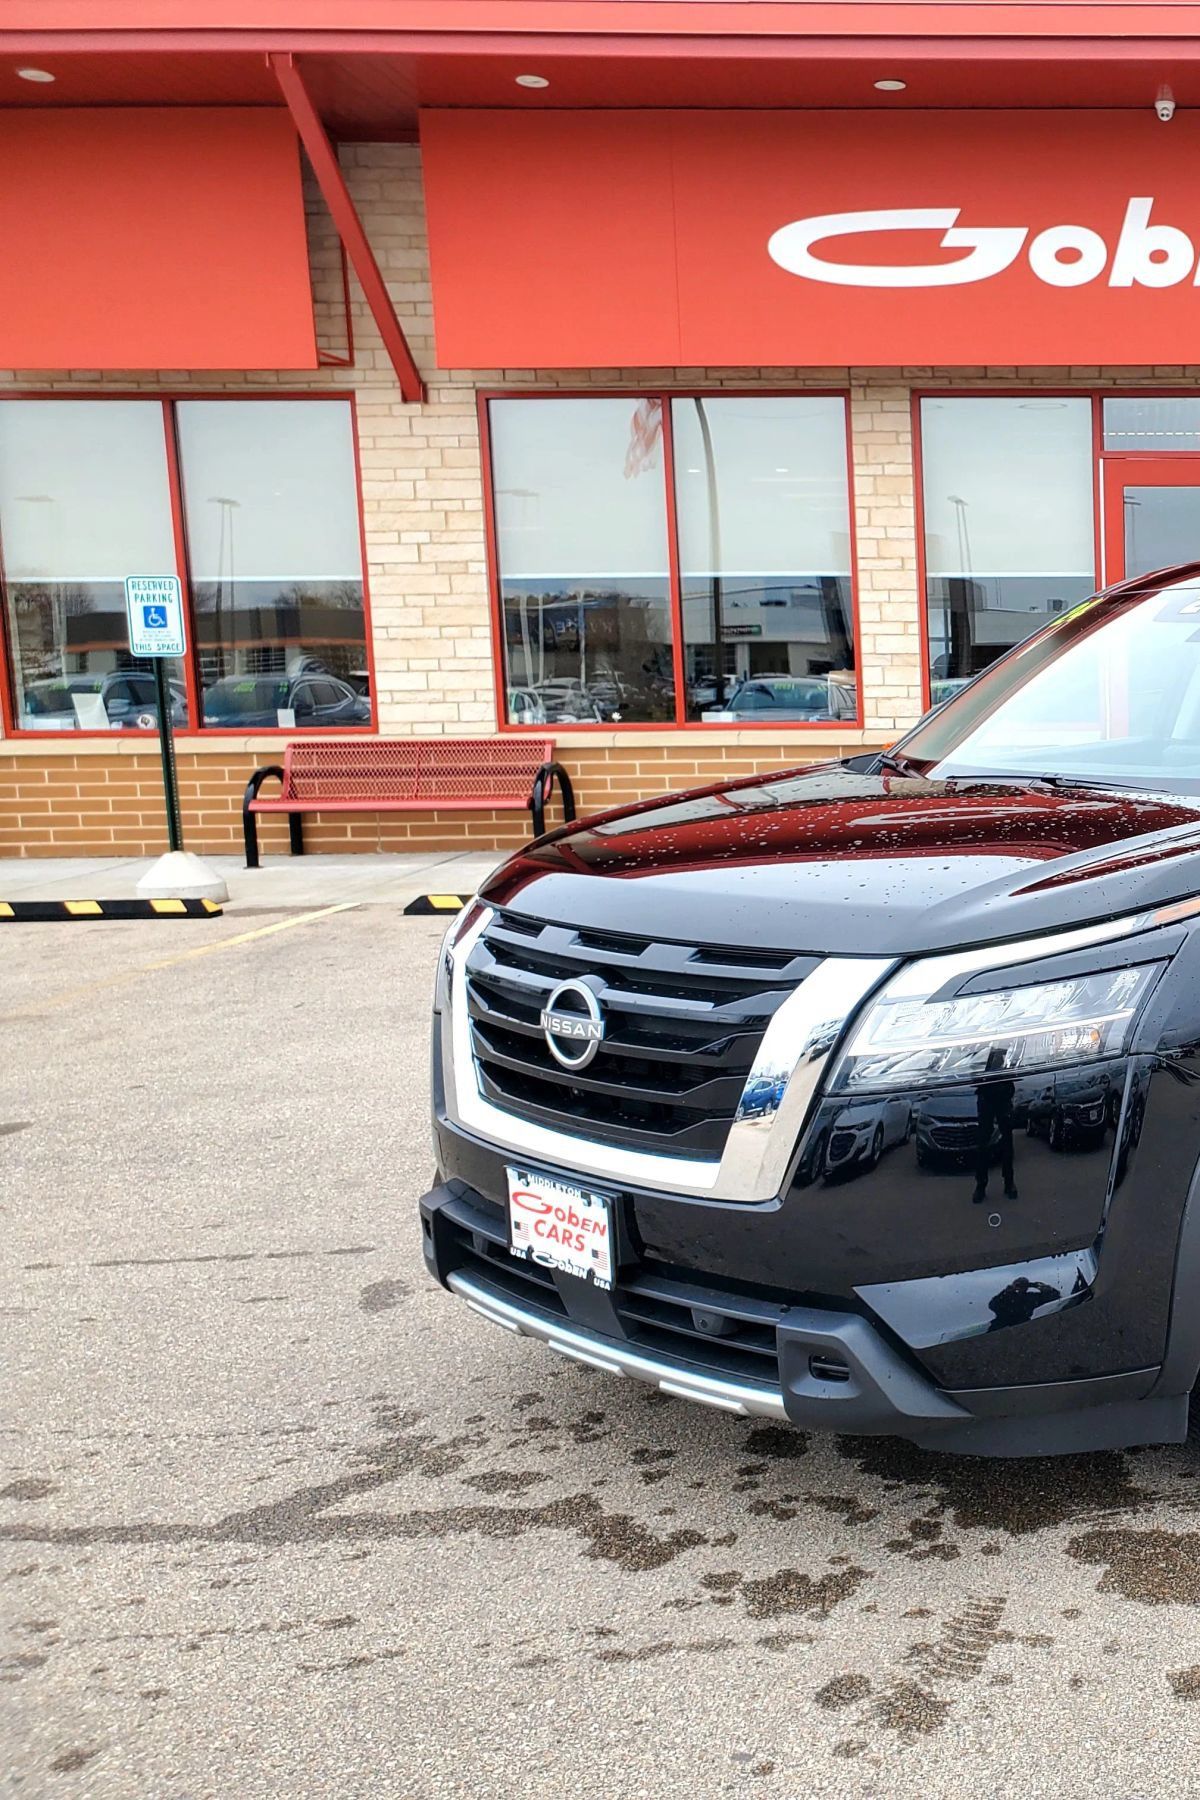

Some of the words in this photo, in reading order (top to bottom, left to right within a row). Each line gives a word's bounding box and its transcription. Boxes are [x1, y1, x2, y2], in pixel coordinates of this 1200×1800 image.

[131, 580, 174, 591] RESERVED
[134, 593, 173, 603] PARKING
[135, 643, 152, 651] THIS
[157, 643, 180, 651] SPACE
[541, 1013, 601, 1038] NISSAN
[527, 1172, 581, 1199] MIDDLETON
[534, 1218, 585, 1252] CARS
[510, 1246, 527, 1260] USA
[593, 1277, 611, 1291] USA
